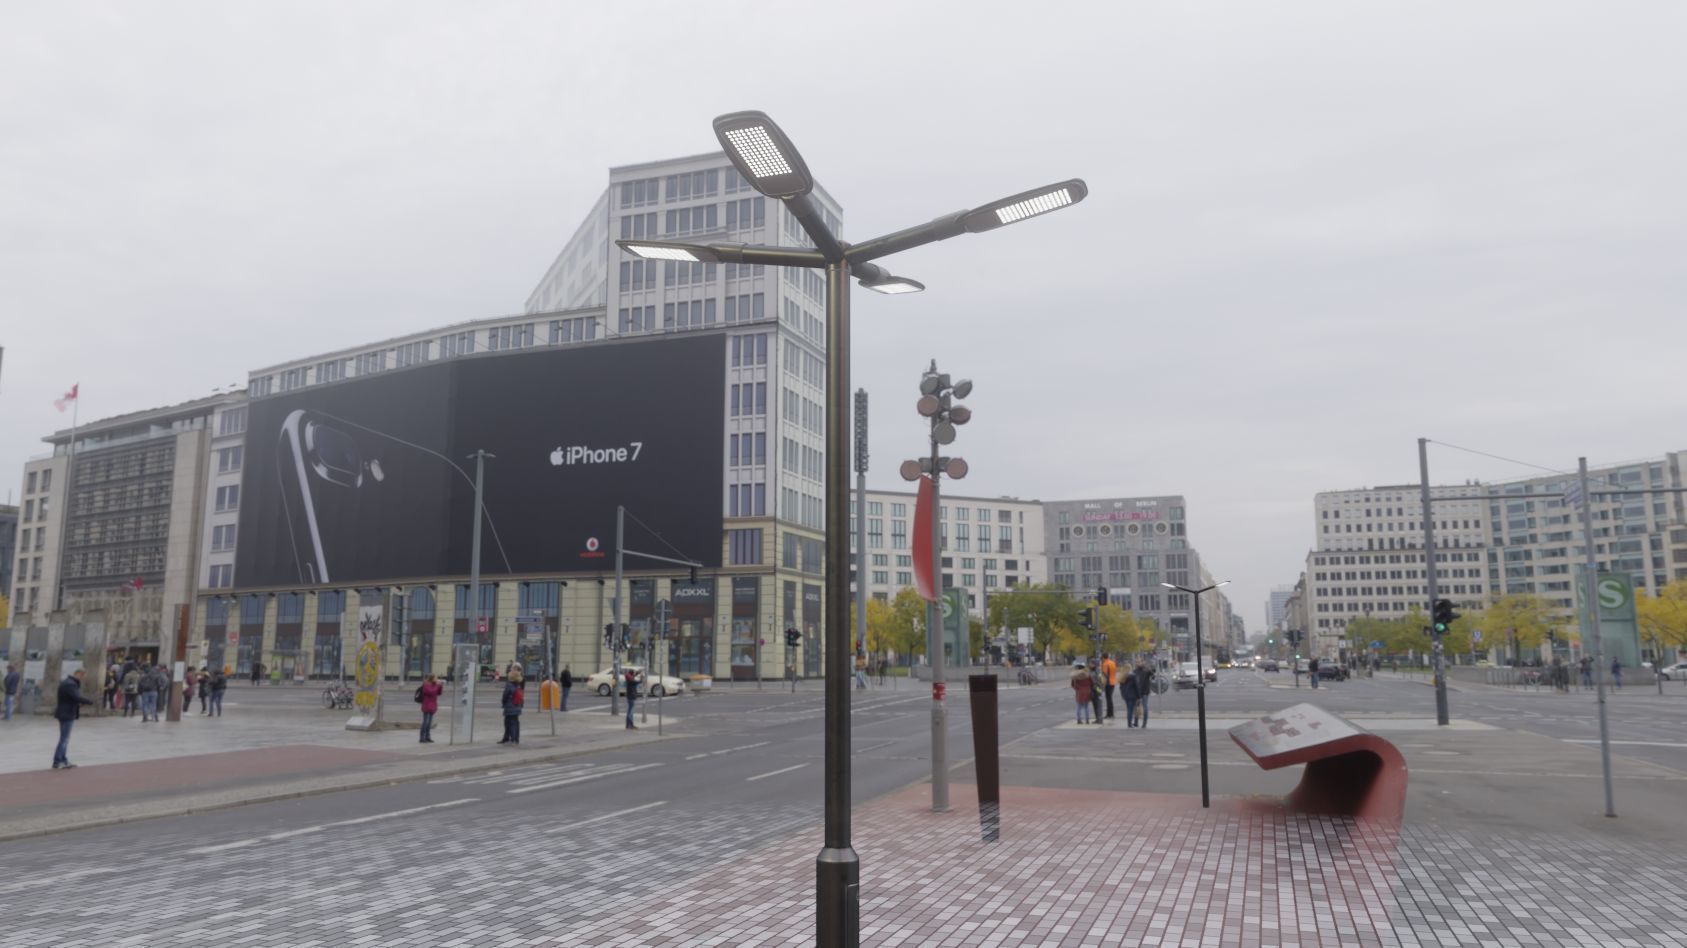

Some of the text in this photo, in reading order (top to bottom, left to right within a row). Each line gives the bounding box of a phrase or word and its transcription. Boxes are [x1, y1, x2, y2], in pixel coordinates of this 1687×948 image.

[566, 441, 643, 465] iPhone 7
[1598, 580, 1624, 609] S
